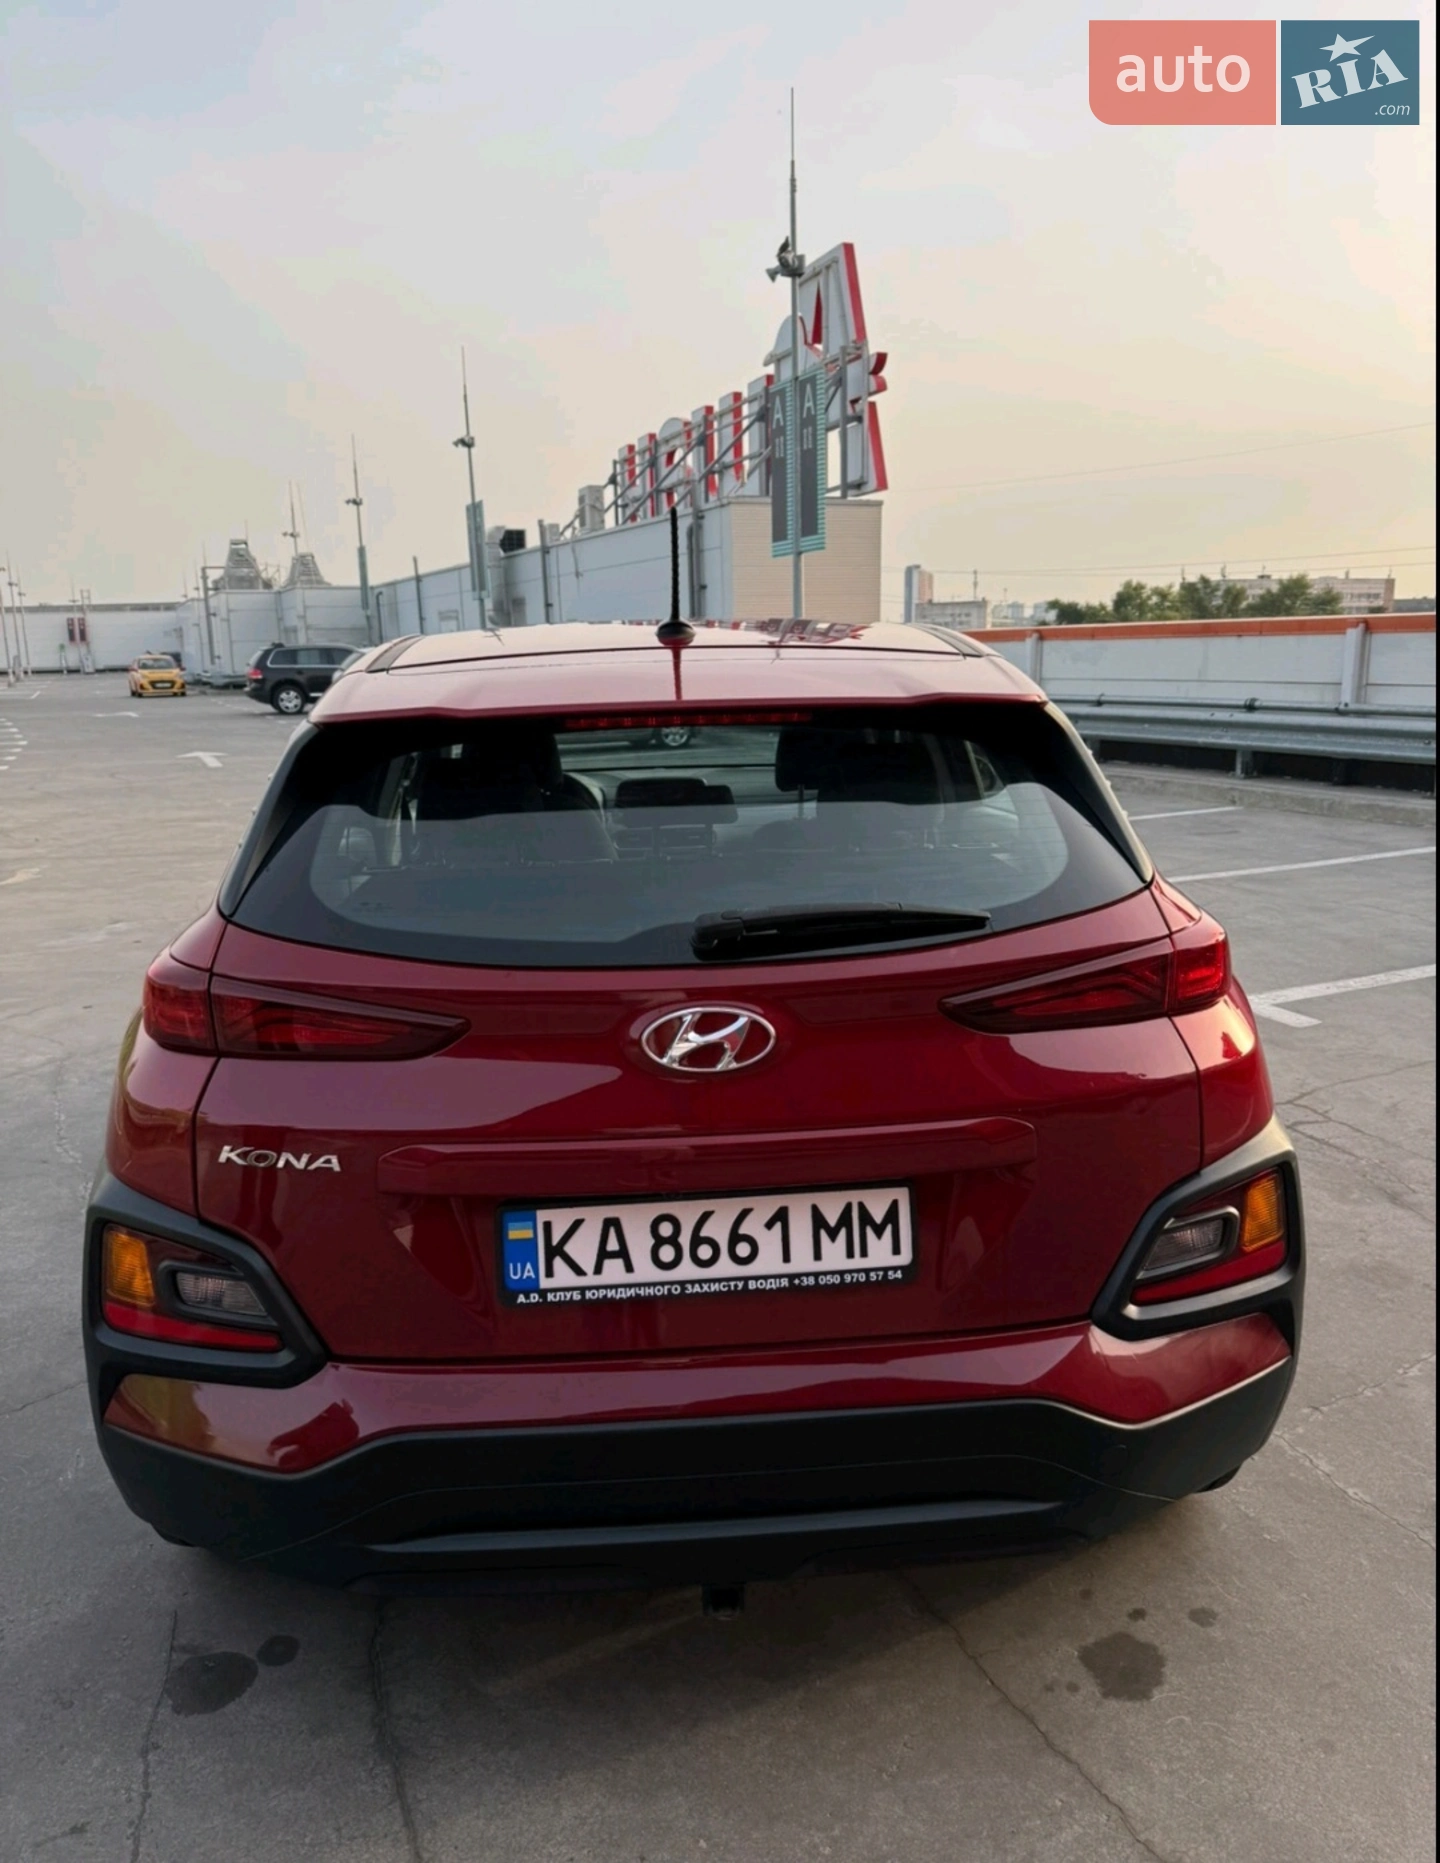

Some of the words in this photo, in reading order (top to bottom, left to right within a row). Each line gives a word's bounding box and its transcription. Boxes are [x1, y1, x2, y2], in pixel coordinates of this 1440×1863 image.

[218, 1145, 342, 1172] KONA
[543, 1216, 635, 1279] KA
[650, 1206, 791, 1271] 8661
[811, 1198, 902, 1262] MM
[509, 1262, 536, 1280] UA
[547, 1290, 582, 1302] КЛУБ
[585, 1284, 681, 1299] ЮРИДИЧНОГО
[684, 1280, 744, 1294] ЗАХИСТУ
[749, 1278, 789, 1290] ВОДІЯ
[793, 1275, 816, 1286] +38
[818, 1273, 841, 1285] 050
[844, 1272, 867, 1283] 970
[869, 1271, 884, 1281] 57
[887, 1269, 902, 1280] 54
